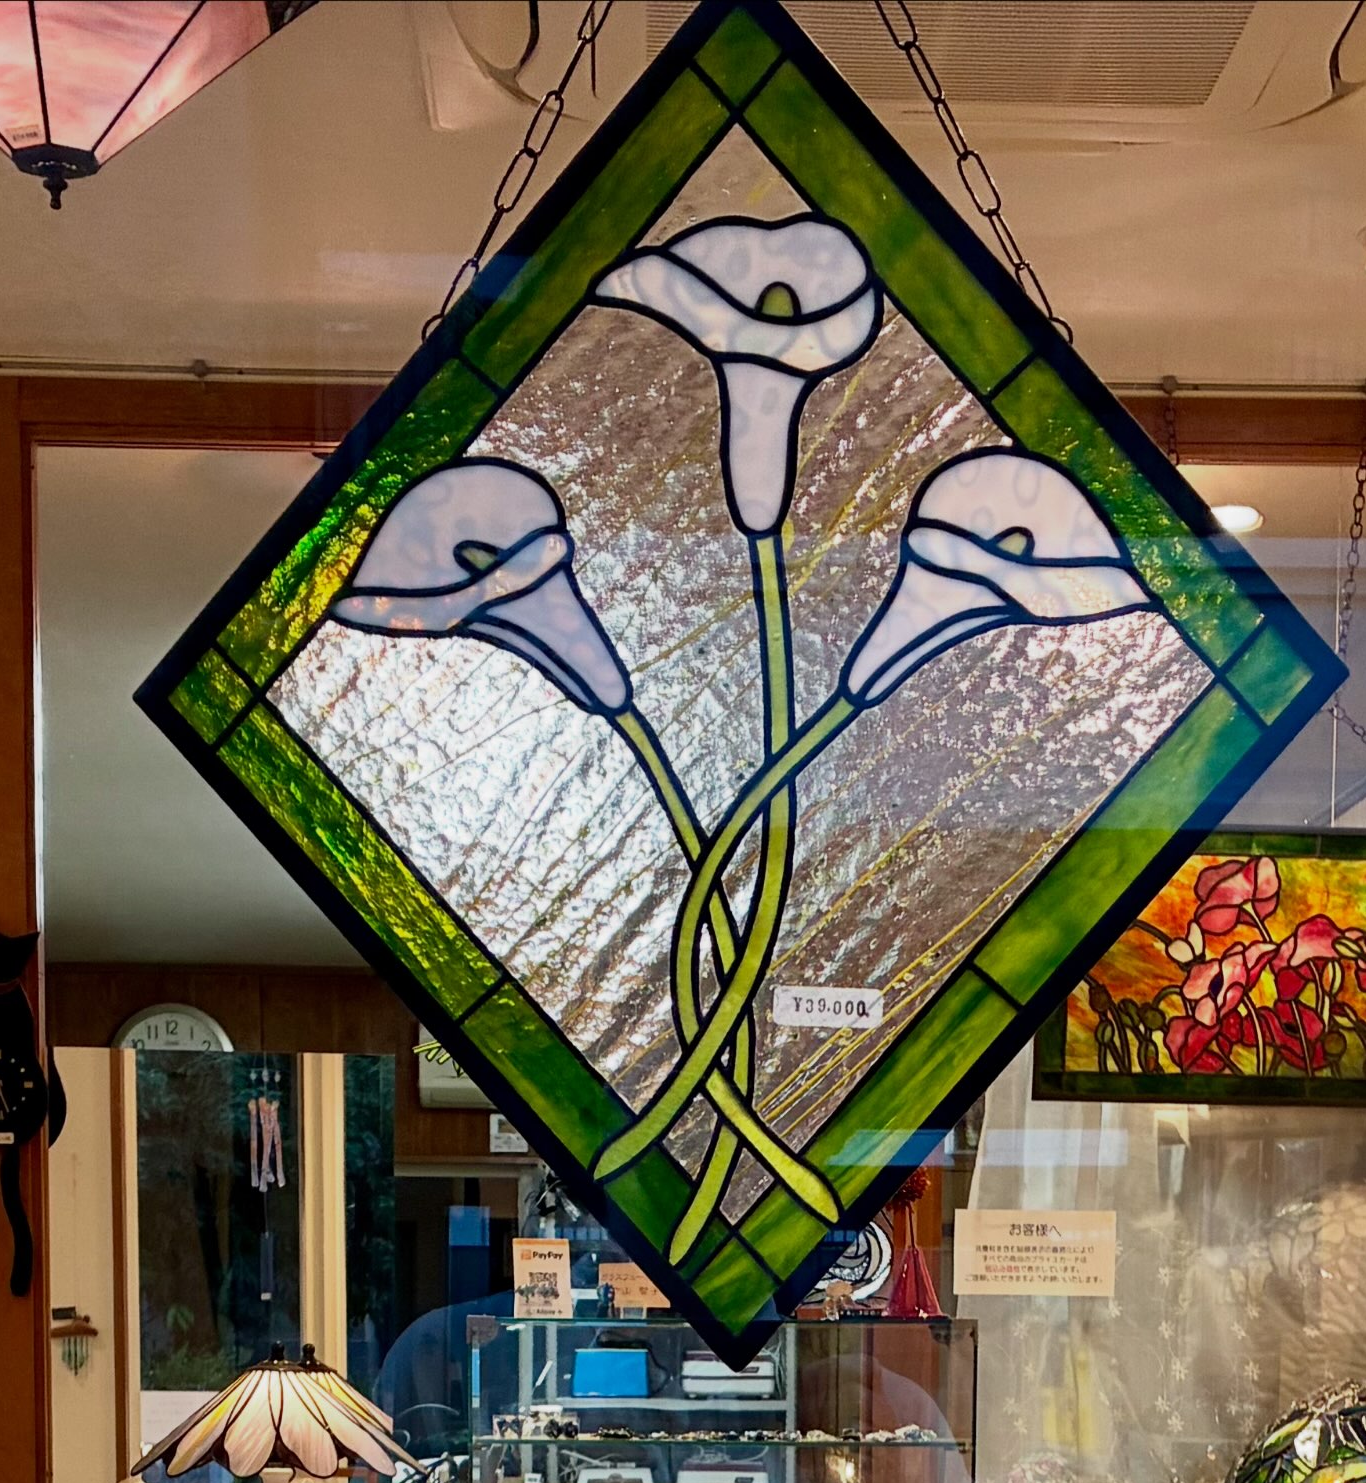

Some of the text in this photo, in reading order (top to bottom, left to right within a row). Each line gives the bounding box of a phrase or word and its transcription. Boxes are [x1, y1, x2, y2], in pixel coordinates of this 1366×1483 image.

[147, 1025, 158, 1040] 11
[165, 1020, 178, 1036] 12
[1009, 1223, 1062, 1237] お客様へ
[532, 1251, 563, 1260] PayPay
